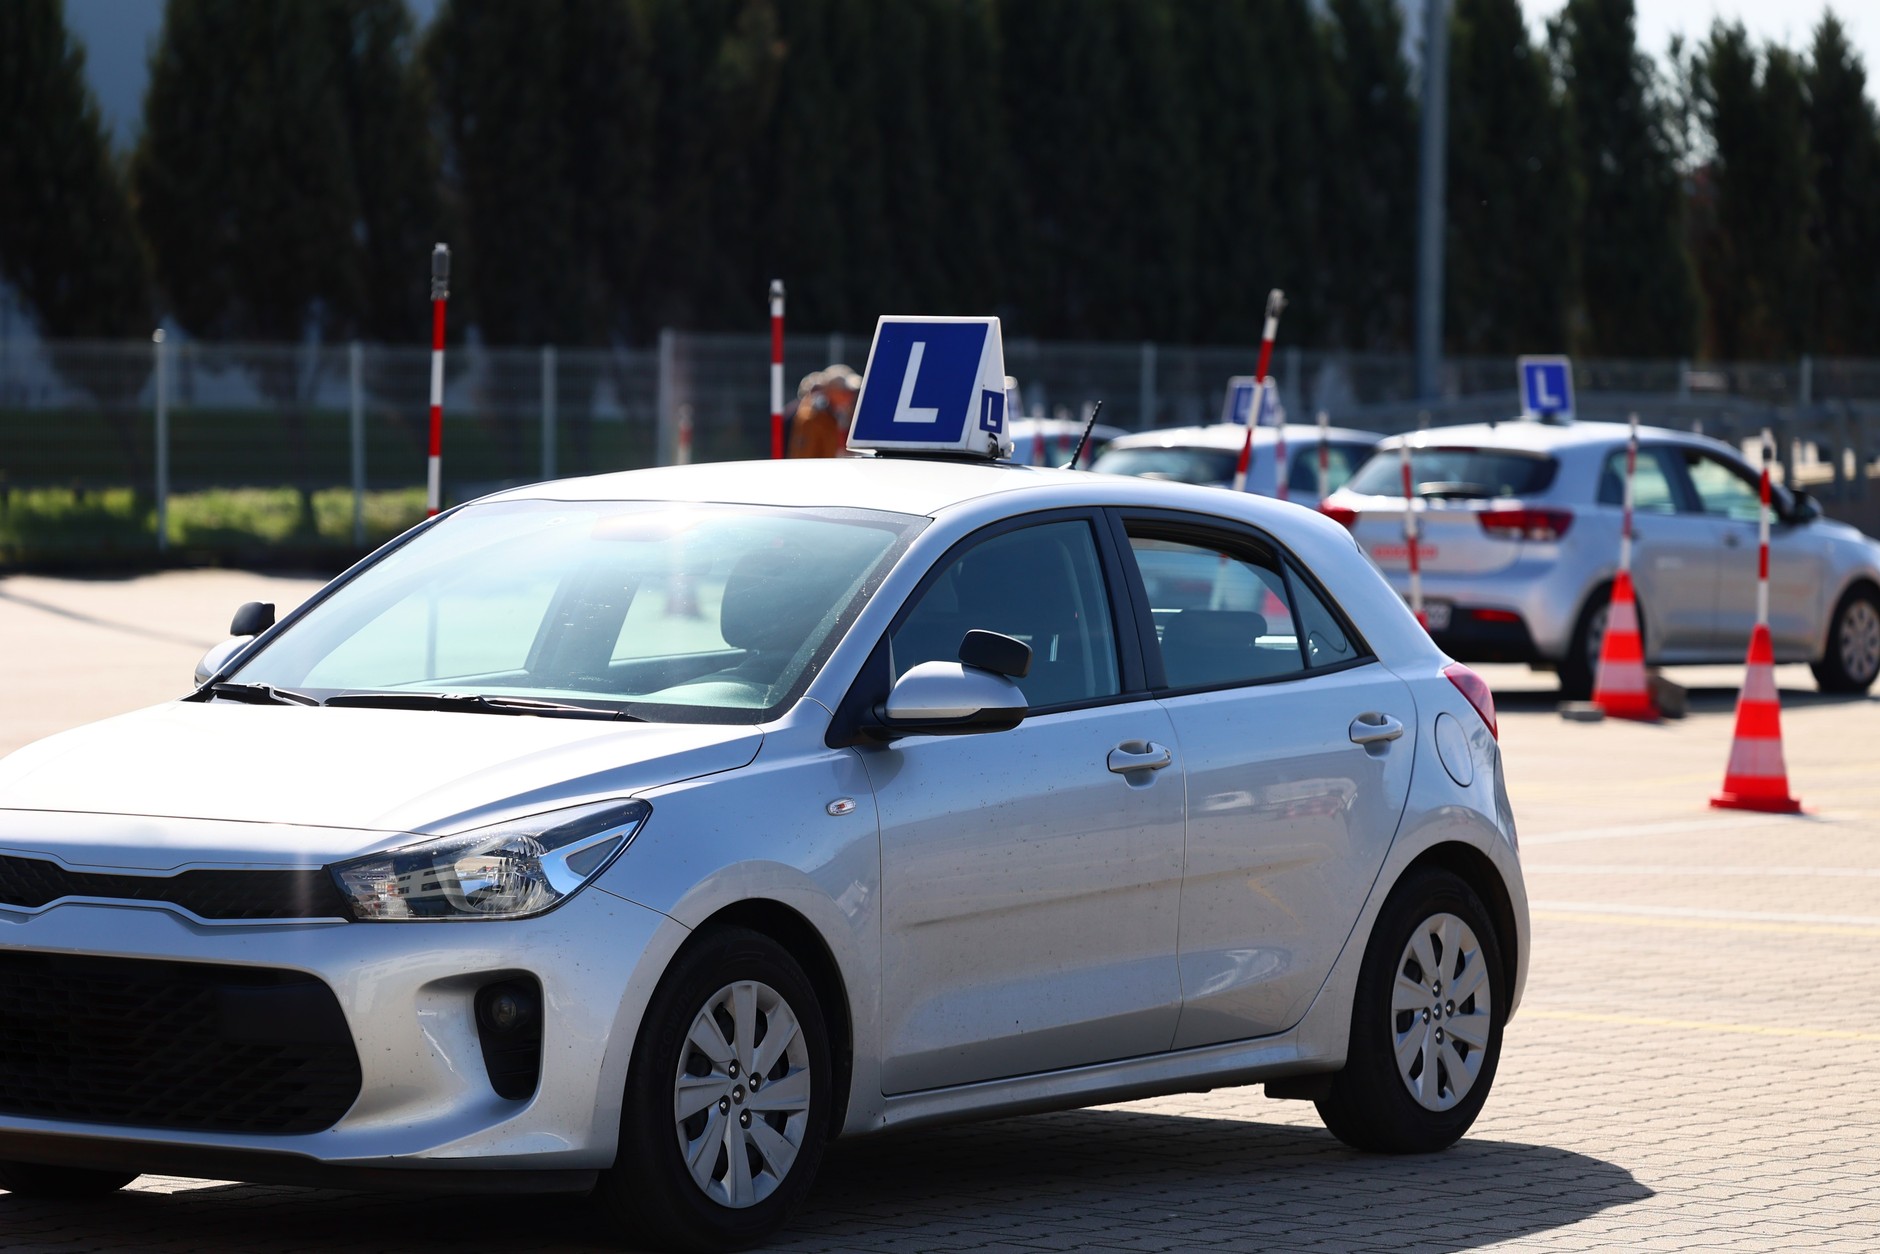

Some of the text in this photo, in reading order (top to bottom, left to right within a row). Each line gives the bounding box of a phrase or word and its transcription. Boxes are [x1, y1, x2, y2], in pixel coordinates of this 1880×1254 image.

[893, 341, 939, 423] L
[1535, 368, 1561, 406] L
[987, 397, 997, 427] L
